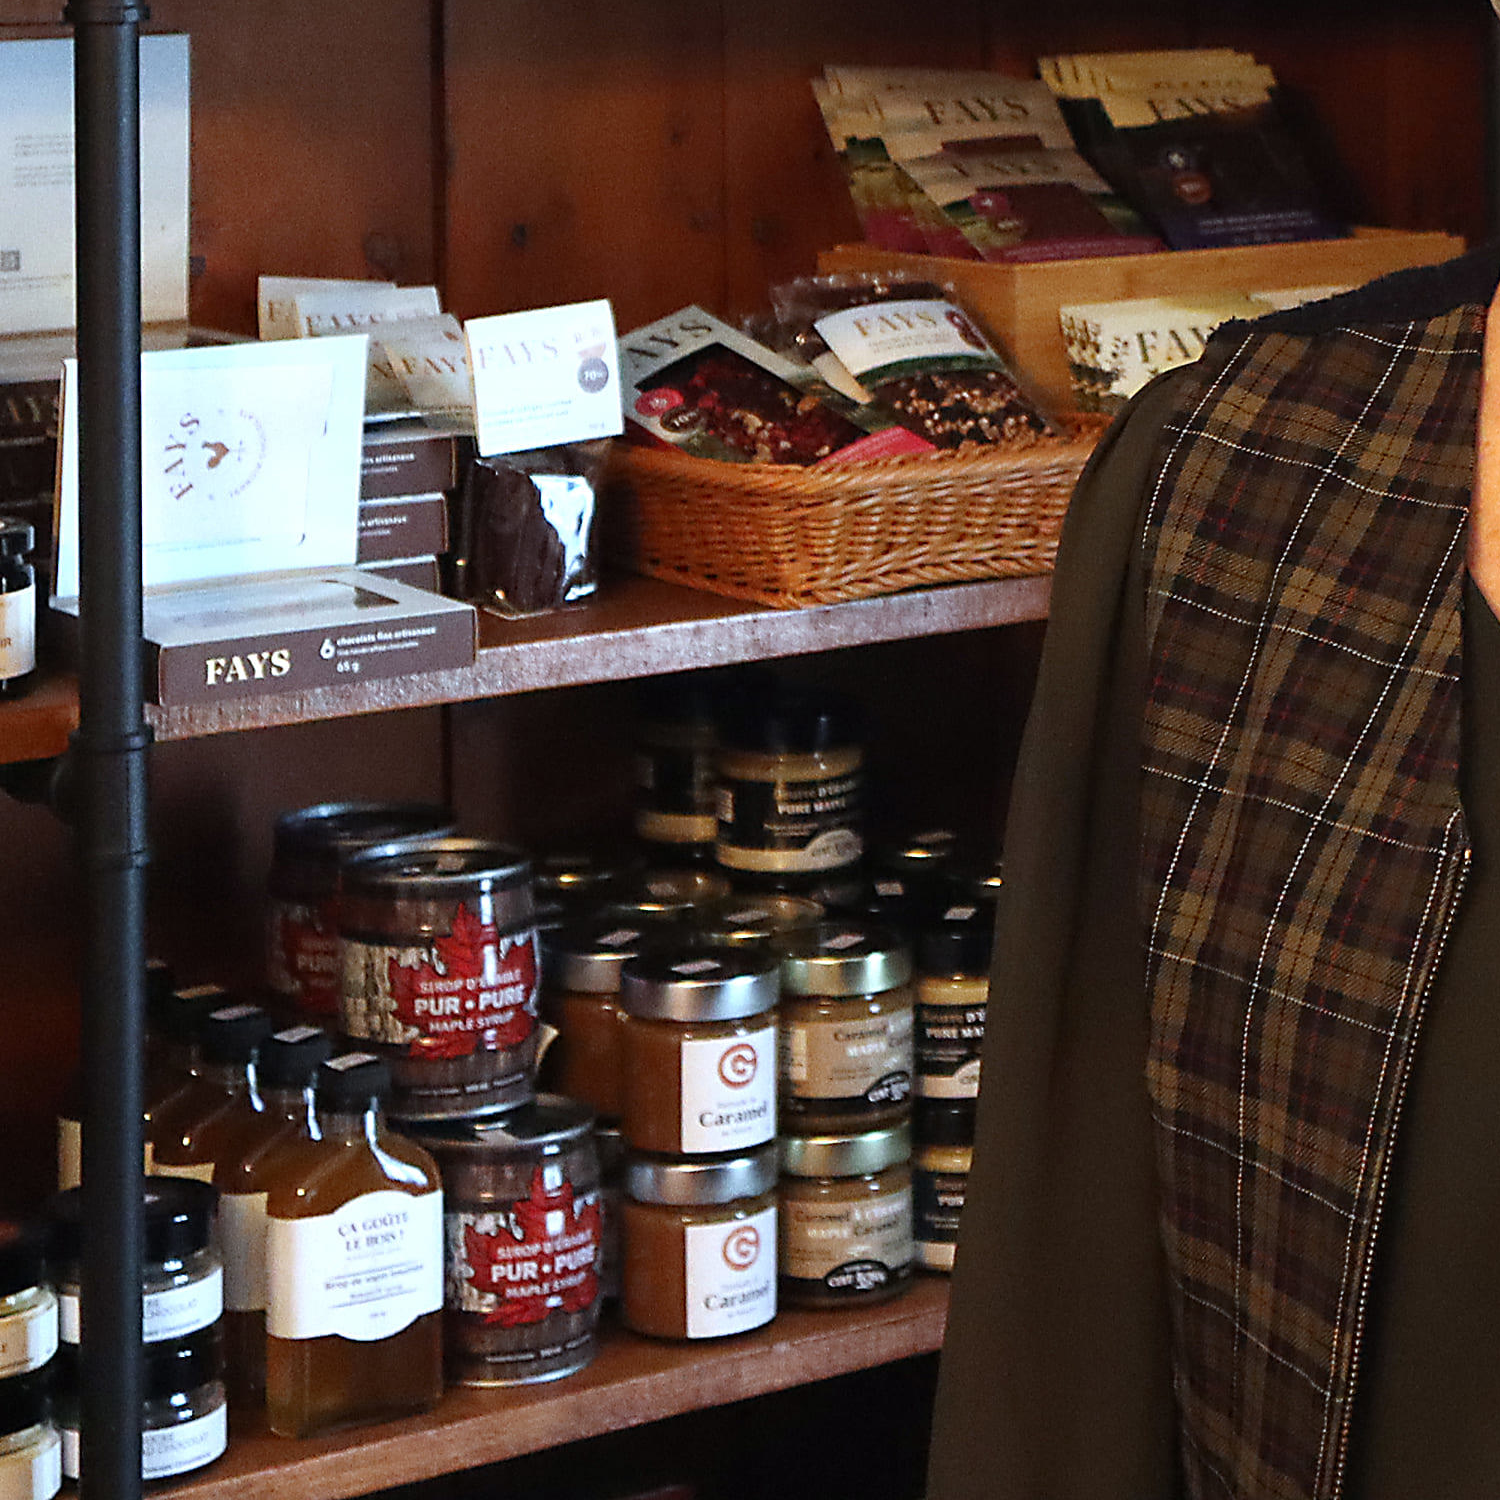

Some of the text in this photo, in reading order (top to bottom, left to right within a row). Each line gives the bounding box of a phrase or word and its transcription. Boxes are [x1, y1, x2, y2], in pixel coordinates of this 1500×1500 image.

[853, 311, 938, 338] FAYS
[320, 638, 335, 660] 6
[206, 648, 291, 685] FAYS
[414, 984, 525, 1016] PUR PURE
[429, 1017, 475, 1033] MAPLE
[699, 1101, 769, 1128] Caramel
[491, 1244, 596, 1283] PUR PURE
[505, 1281, 549, 1299] MAPLE
[704, 1279, 770, 1311] Caramel
